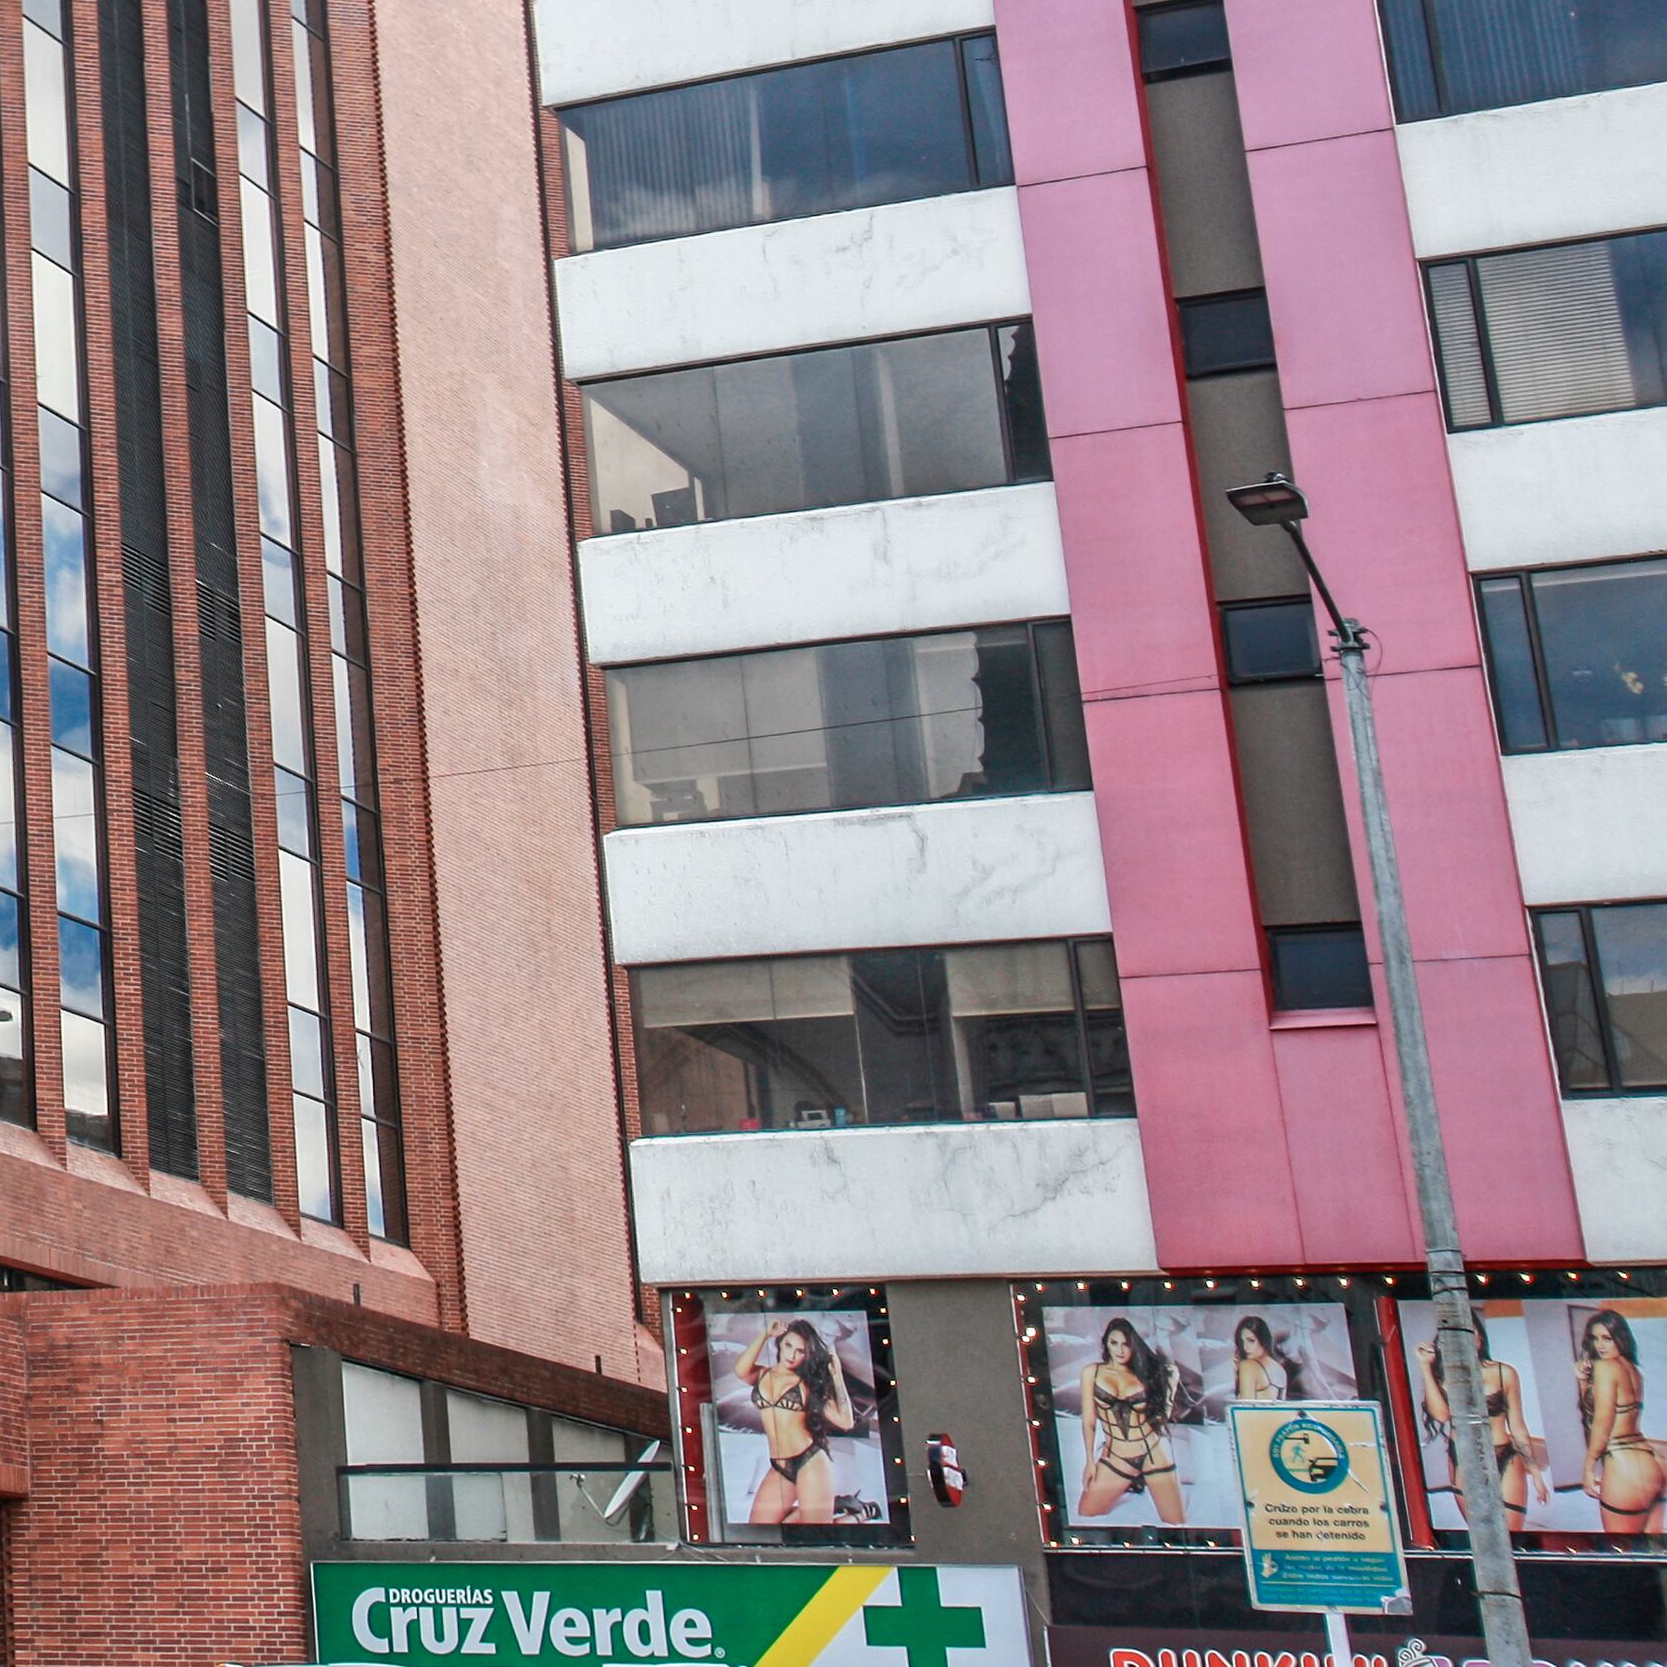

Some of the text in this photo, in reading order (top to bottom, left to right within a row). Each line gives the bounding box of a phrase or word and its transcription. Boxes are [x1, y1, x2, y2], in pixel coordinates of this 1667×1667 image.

[1265, 1503, 1369, 1515] Cruzo por la cebra
[1269, 1517, 1369, 1528] cuando los carros
[1276, 1530, 1289, 1539] se
[1292, 1530, 1312, 1540] han
[389, 1586, 493, 1604] DROGUERÍAS
[352, 1587, 712, 1658] Cruz Verde
